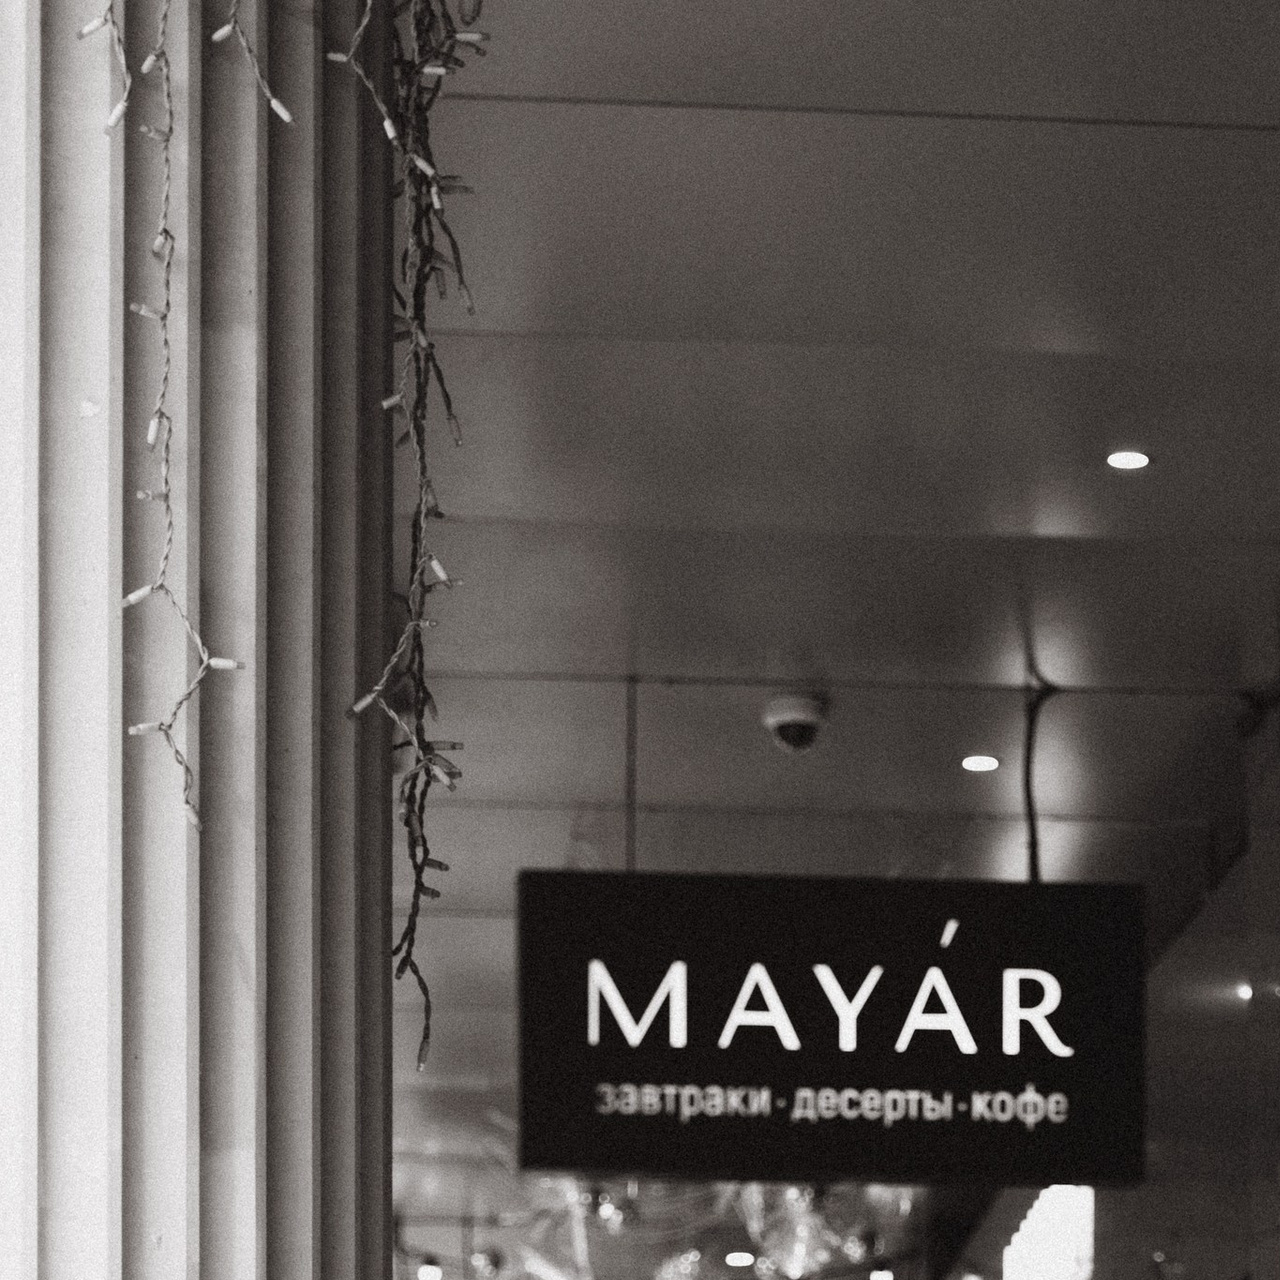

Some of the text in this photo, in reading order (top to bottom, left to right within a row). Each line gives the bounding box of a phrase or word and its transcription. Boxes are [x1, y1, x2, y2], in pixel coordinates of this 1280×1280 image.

[587, 918, 1075, 1057] MAYÁR
[597, 1083, 1069, 1130] завтраки десерты кофе
